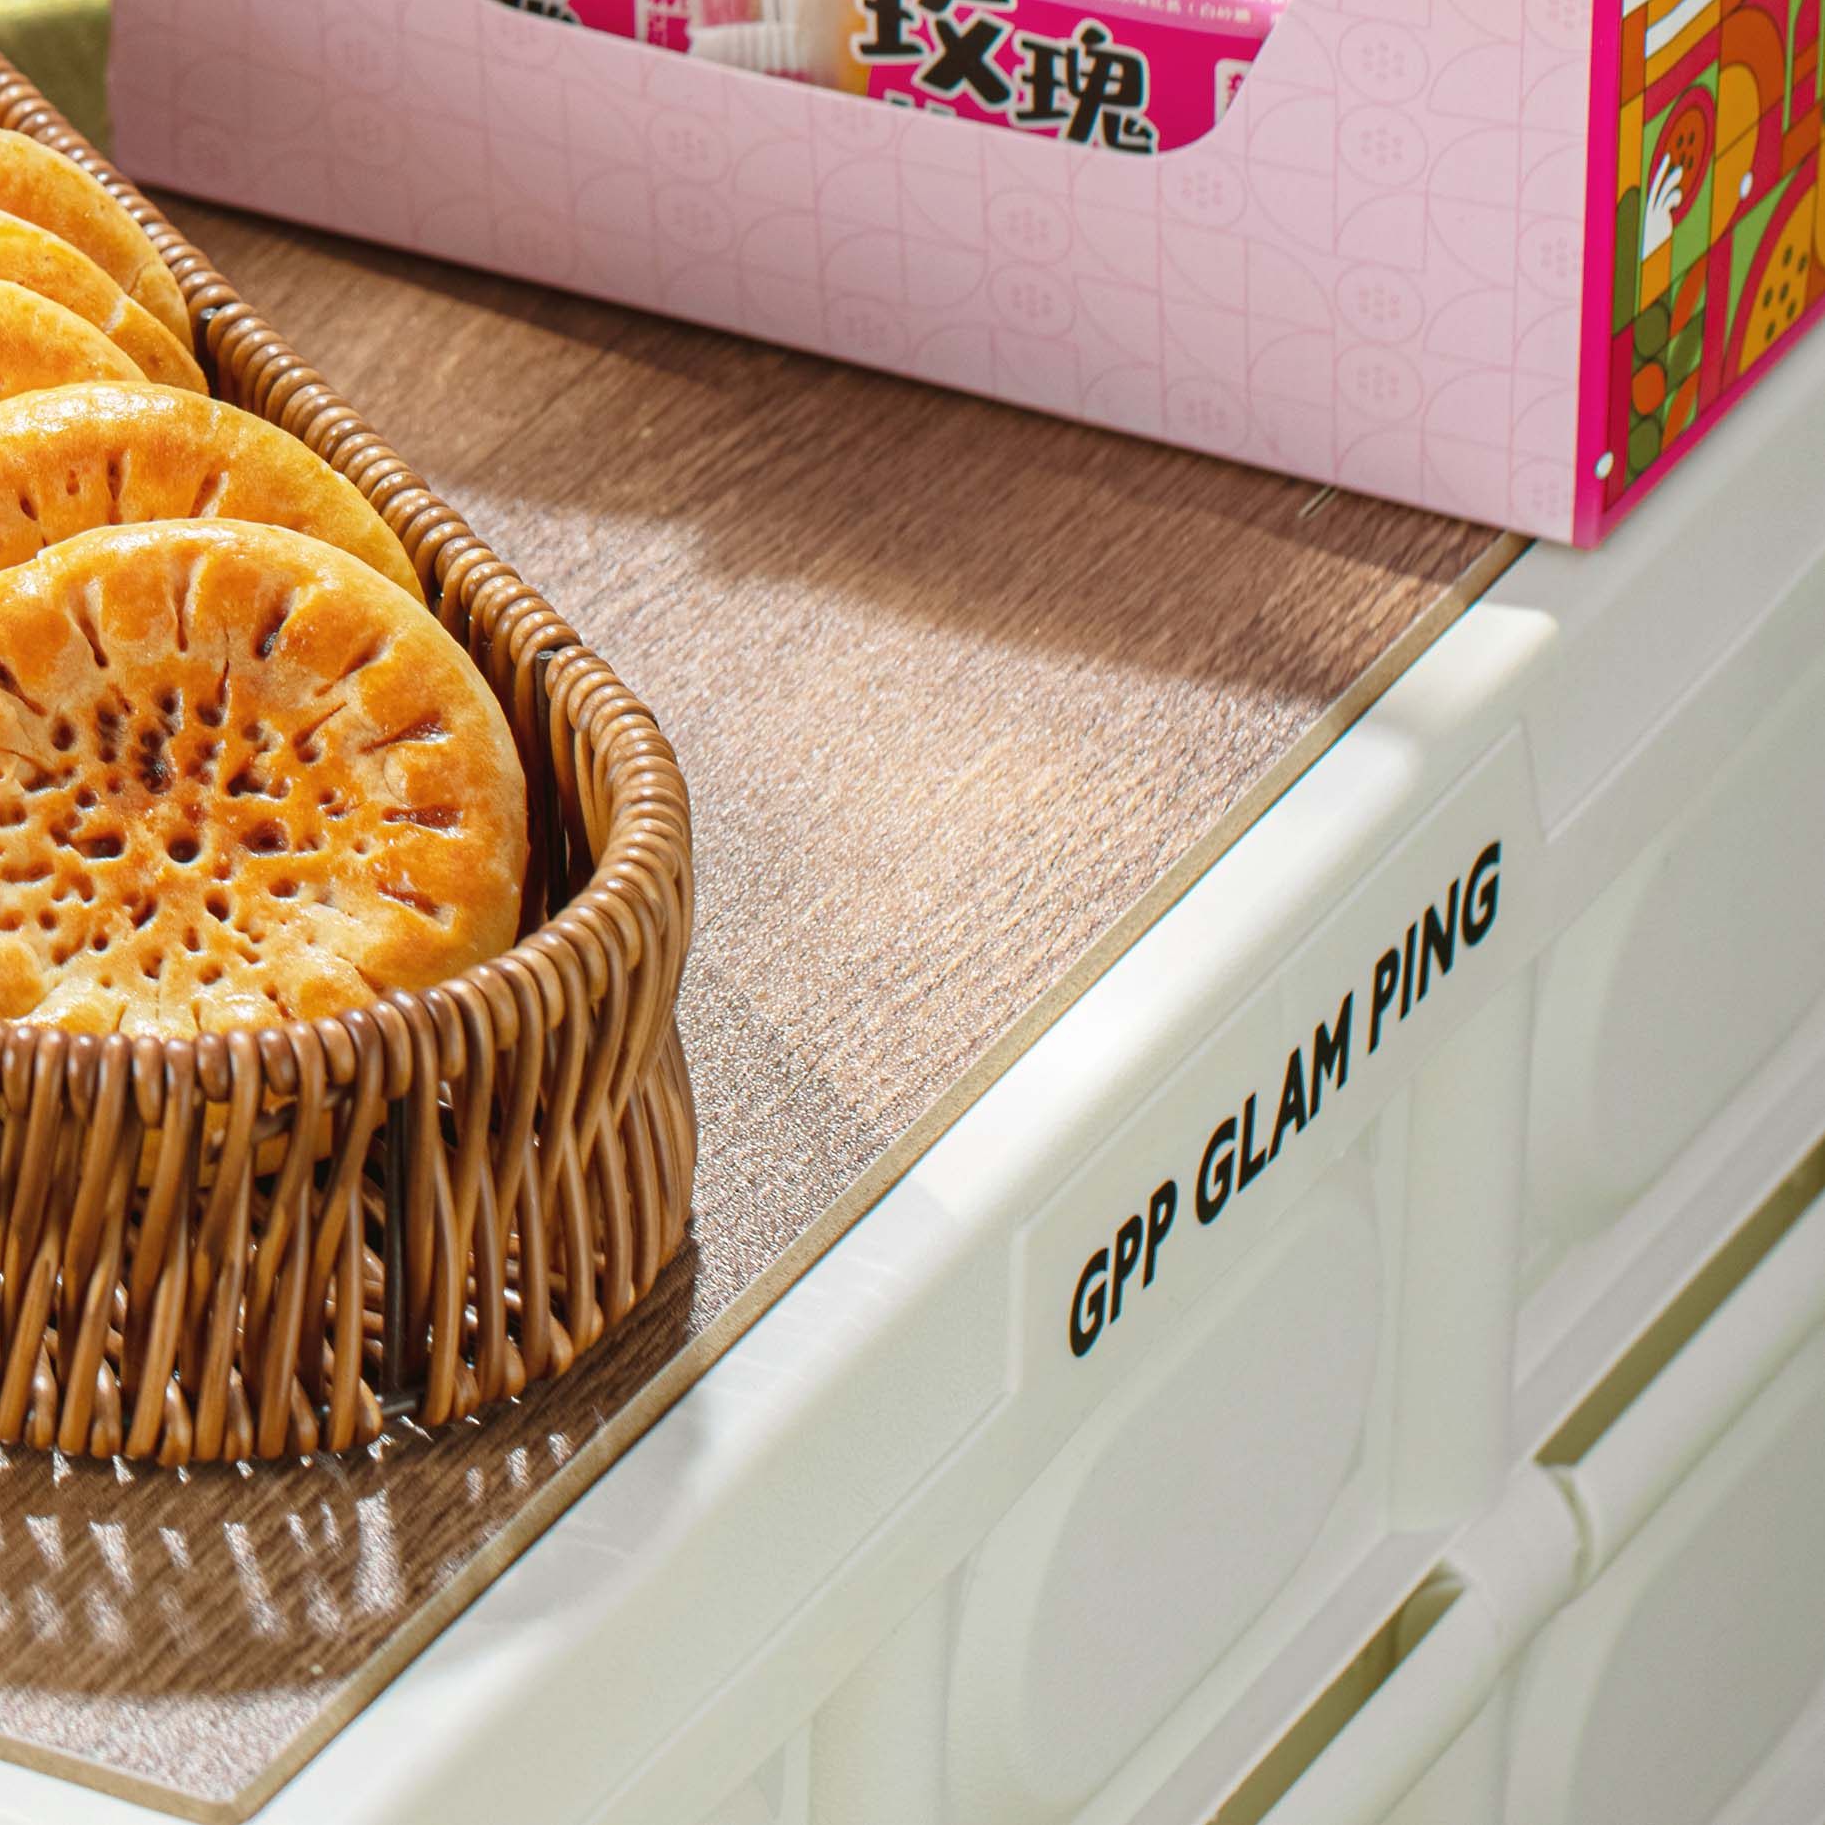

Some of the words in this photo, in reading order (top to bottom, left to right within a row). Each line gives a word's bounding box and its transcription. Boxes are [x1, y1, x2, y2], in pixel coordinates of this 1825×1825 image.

[1069, 1179, 1178, 1358] GPP
[1194, 990, 1354, 1225] GLAM
[1368, 839, 1502, 1055] PING
